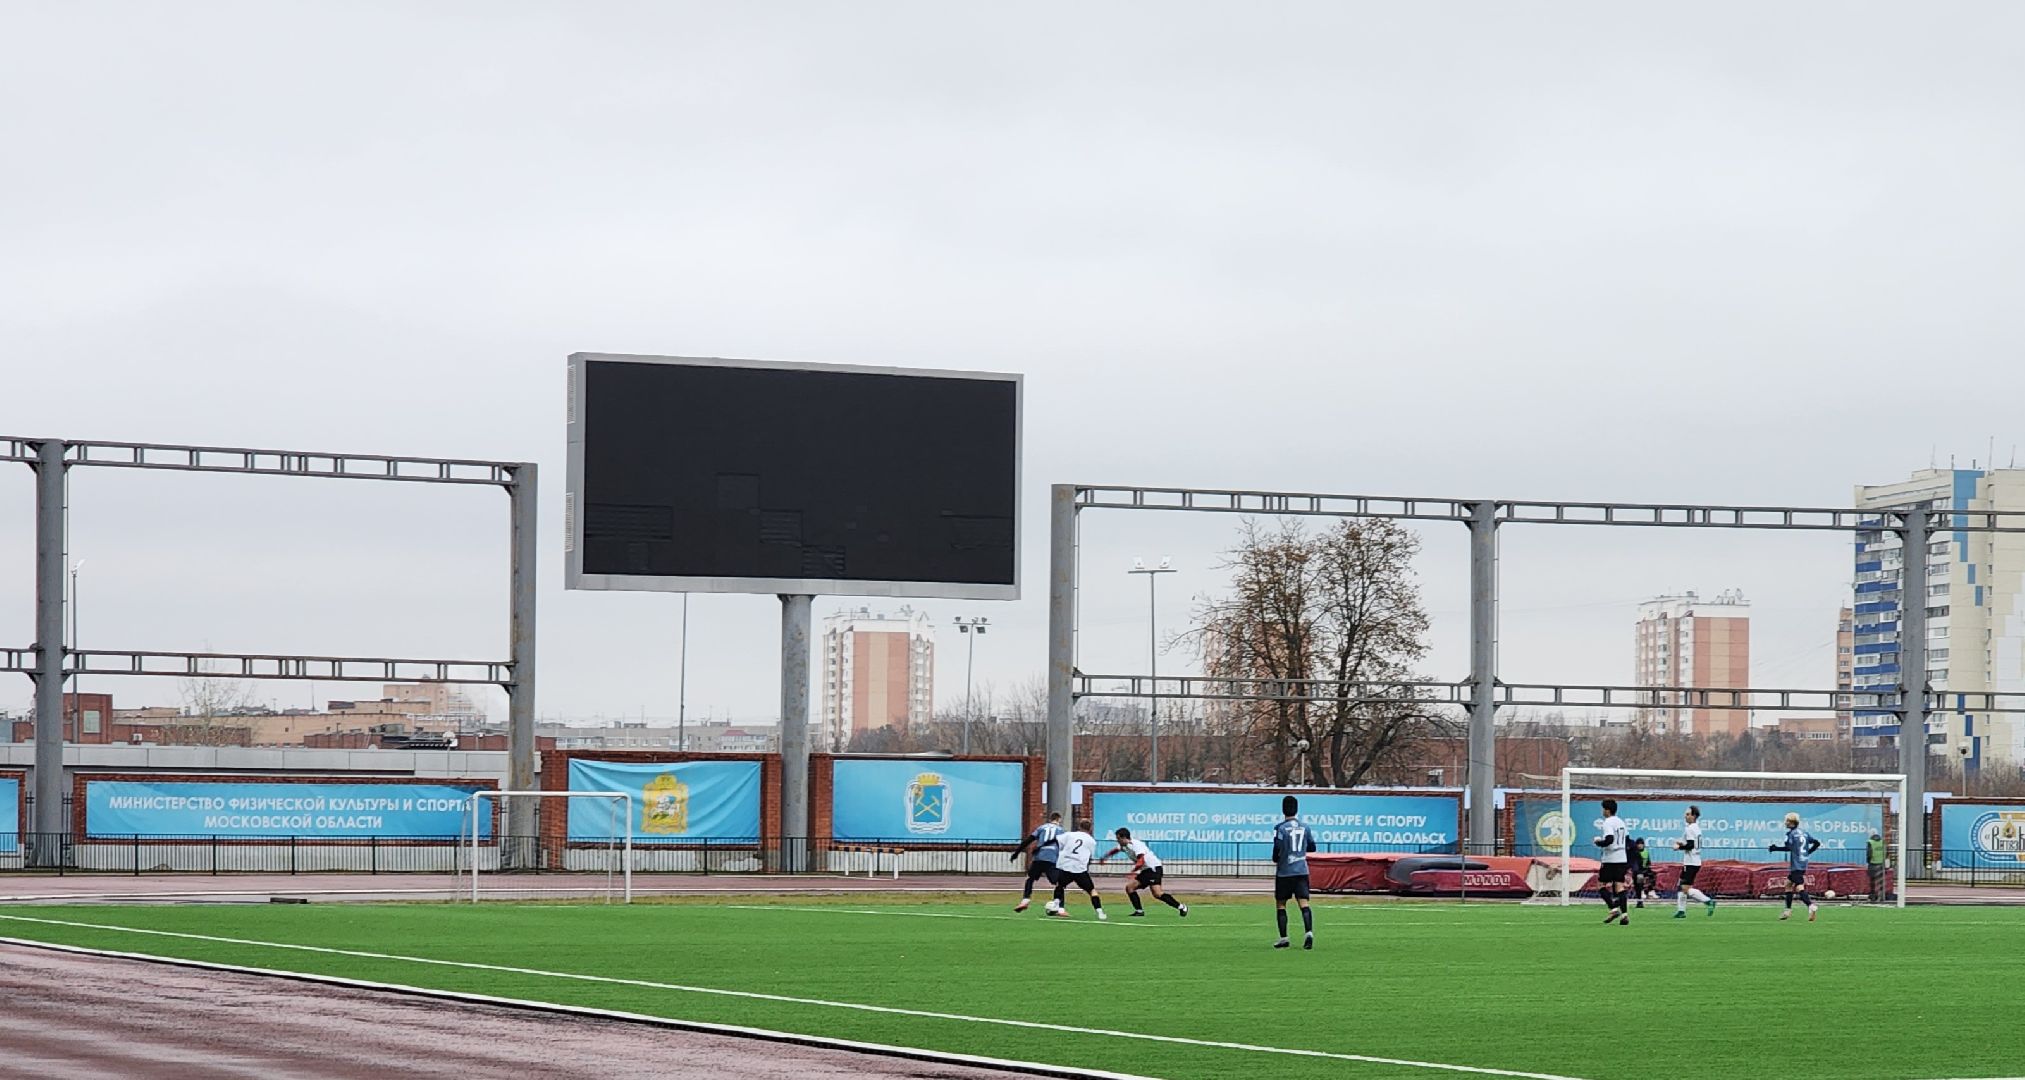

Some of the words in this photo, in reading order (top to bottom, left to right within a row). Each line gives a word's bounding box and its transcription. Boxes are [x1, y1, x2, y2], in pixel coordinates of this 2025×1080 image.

[109, 796, 225, 811] МИНИСТЕРСТВО
[228, 795, 325, 811] ФИЗИЧЕСКОЙ
[329, 798, 399, 812] КУЛЬТУРЫ
[403, 799, 413, 811] И
[416, 799, 472, 812] СПОРТА
[203, 813, 312, 828] МОСКОВСКОЙ
[315, 815, 382, 829] ОБЛАСТИ
[1127, 812, 1186, 824] КОМИТЕТ
[1188, 813, 1208, 824] ПО
[1211, 813, 1298, 825] ФИЗИЧЕСК
[1303, 814, 1361, 826] КУЛЬТУРЕ
[1365, 815, 1373, 826] И
[1377, 815, 1427, 828] СПОРТУ
[1593, 818, 1681, 832] ФЕРАЦИЯ
[1814, 819, 1872, 833] БОРЬБЫ
[1228, 830, 1319, 843] ГОРОДО
[1322, 831, 1373, 843] ОКРУГА
[1374, 832, 1447, 845] ПОДОЛЬСК
[1290, 827, 1306, 852] 17
[1799, 836, 1807, 853] 2
[1072, 838, 1083, 854] 2
[1463, 874, 1511, 886] MONDO
